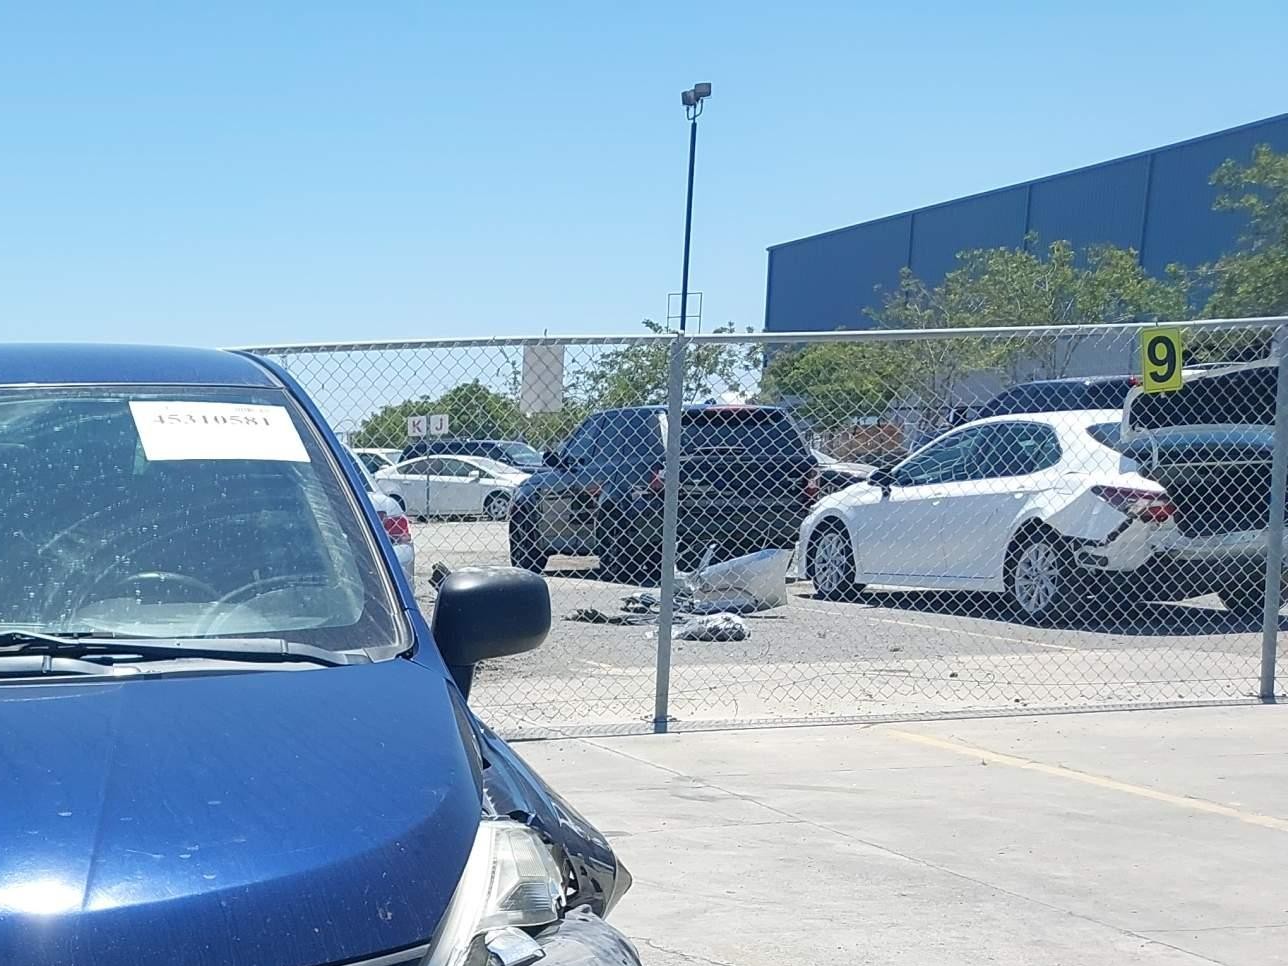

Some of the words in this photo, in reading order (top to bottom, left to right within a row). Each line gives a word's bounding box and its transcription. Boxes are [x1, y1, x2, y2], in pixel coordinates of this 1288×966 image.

[1147, 335, 1177, 384] 9
[412, 420, 422, 433] K
[435, 417, 444, 431] J
